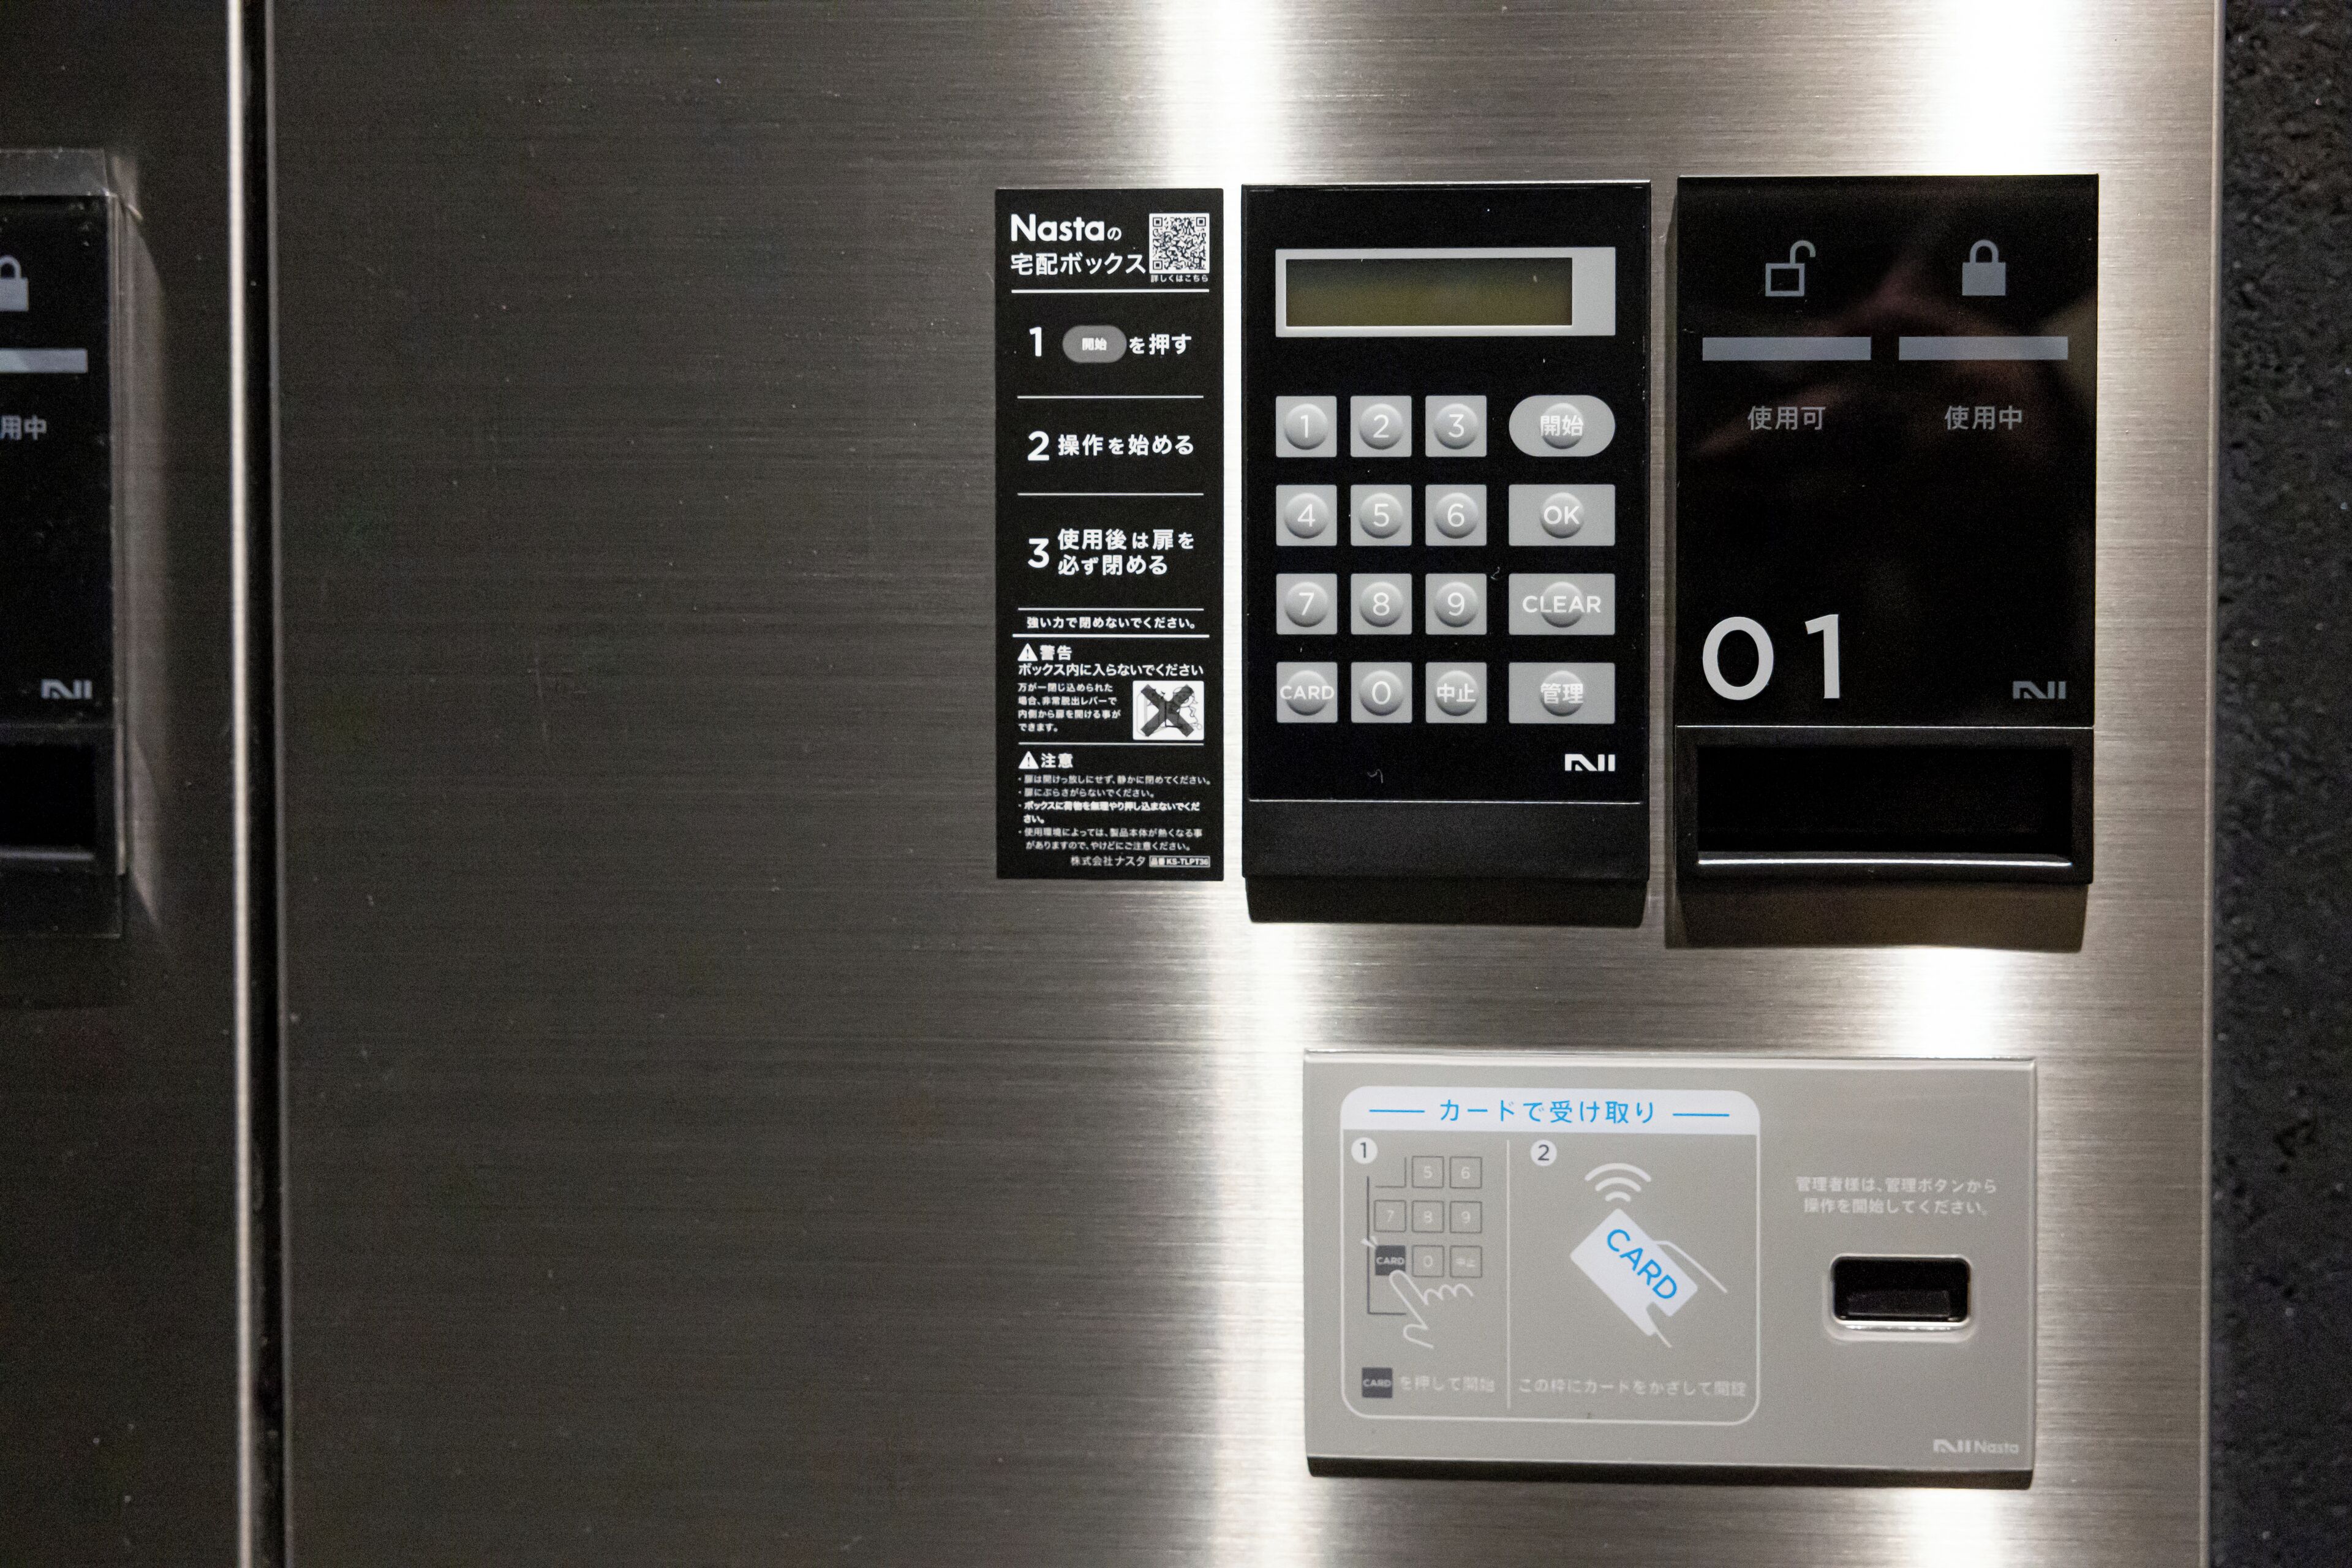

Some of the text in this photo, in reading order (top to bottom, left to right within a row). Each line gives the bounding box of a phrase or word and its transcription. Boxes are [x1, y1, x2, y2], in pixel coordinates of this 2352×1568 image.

[1011, 214, 1121, 241] Nastaの
[1010, 252, 1145, 276] 宅配ボックス
[1029, 327, 1191, 356] 1 開始 を押す
[1300, 415, 1309, 437] 1
[1372, 414, 1389, 438] 2
[1447, 413, 1464, 438] 3
[1539, 415, 1584, 437] 開始
[1747, 406, 1826, 430] 使用可
[1944, 405, 2022, 430] 使用中
[1027, 431, 1193, 461] 2 操作を始める
[1297, 503, 1316, 527] 4
[1373, 503, 1389, 527] 5
[1447, 503, 1464, 527] 6
[1543, 505, 1581, 525] OK
[1057, 529, 1194, 550] 使用後は扉を
[1027, 538, 1049, 568] 3
[1057, 554, 1167, 575] 必ず閉める
[1298, 592, 1315, 616] 7
[1372, 592, 1390, 616] 8
[1447, 592, 1465, 616] 9
[1521, 595, 1601, 614] CLEAR
[1027, 617, 1194, 628] 強い力で閉めないでください。
[1039, 645, 1072, 660] 警告
[1702, 614, 1840, 700] 01
[1018, 663, 1204, 677] ボックス内に入らないでください
[1018, 683, 1112, 692] 万が一閉じ込められた
[1279, 685, 1335, 700] CARD
[1371, 681, 1391, 705] 0
[1436, 683, 1476, 703] 中止
[1539, 682, 1584, 704] 管理
[1018, 696, 1117, 705] 場合、非常脱出レバーで
[1019, 723, 1057, 732] できます。
[1041, 753, 1072, 768] 注意
[1023, 814, 1044, 824] さい。
[1071, 856, 1145, 866] 株式会社ナスタ
[1440, 1099, 1653, 1123] カードで受け取り
[1360, 1142, 1366, 1158] 1
[1537, 1145, 1549, 1161] 2
[1796, 1177, 1996, 1193] 管理者様は、管理ボタンから
[1803, 1198, 1989, 1216] 操作を開始してください。
[1375, 1257, 1406, 1265] CARD
[1607, 1229, 1677, 1299] CARD
